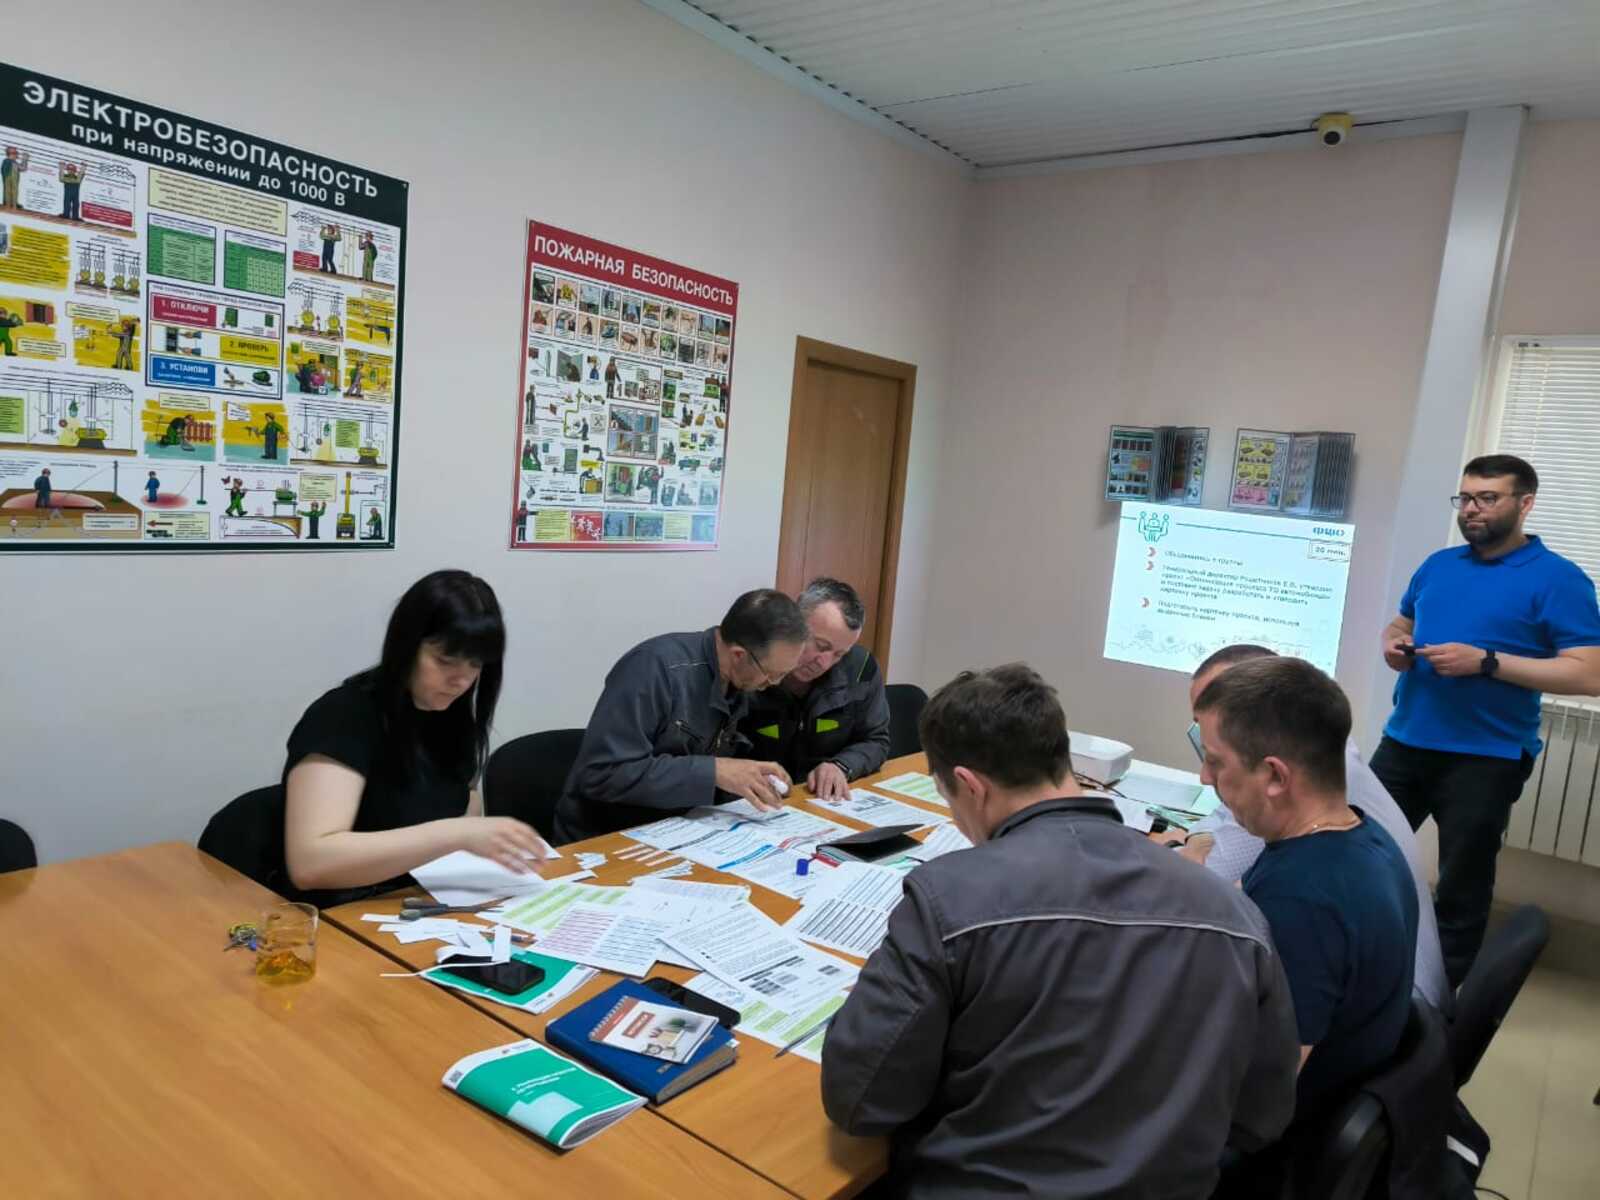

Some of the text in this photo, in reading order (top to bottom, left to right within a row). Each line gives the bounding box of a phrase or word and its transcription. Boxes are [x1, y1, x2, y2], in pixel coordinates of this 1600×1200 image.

[23, 80, 379, 198] ЭЛЕКТРОБЕЗОПАСНОСТЬ
[72, 123, 346, 206] при напряжении до 1000 В
[535, 234, 734, 306] ПОЖАРНАЯ БЕЗОПАСНОСТЬ
